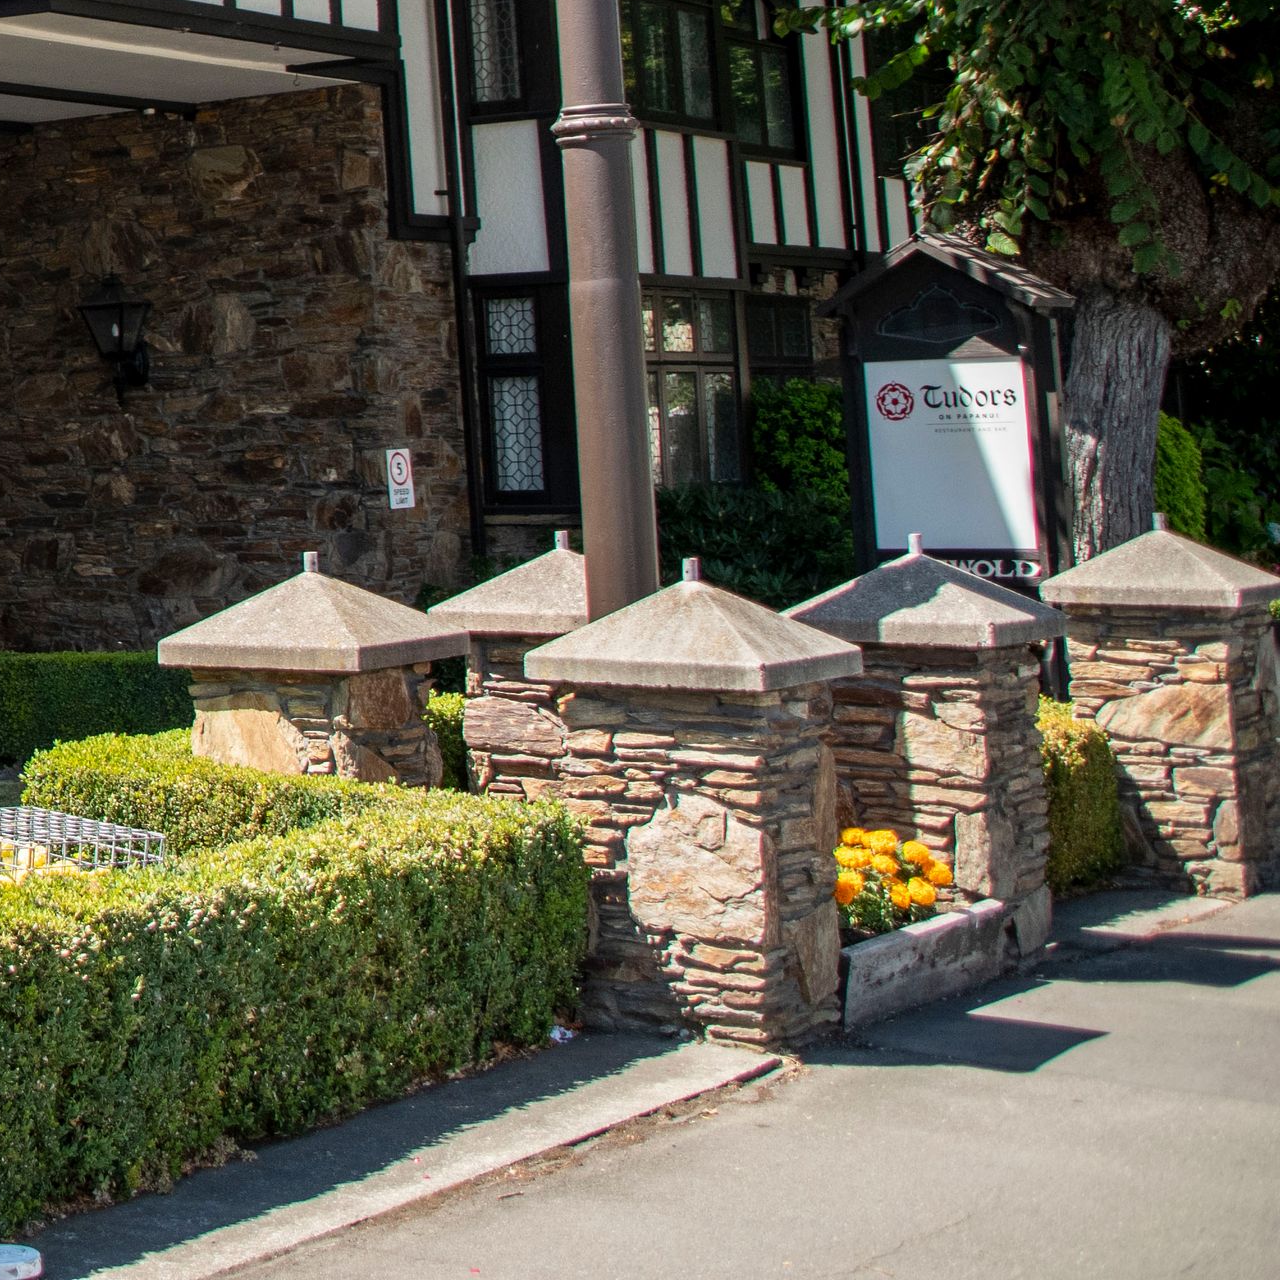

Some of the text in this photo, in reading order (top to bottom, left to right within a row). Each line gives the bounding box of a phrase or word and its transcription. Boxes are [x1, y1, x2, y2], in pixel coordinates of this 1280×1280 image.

[920, 385, 1017, 408] Tudors
[956, 412, 999, 420] PAPANUI
[396, 462, 403, 475] 5
